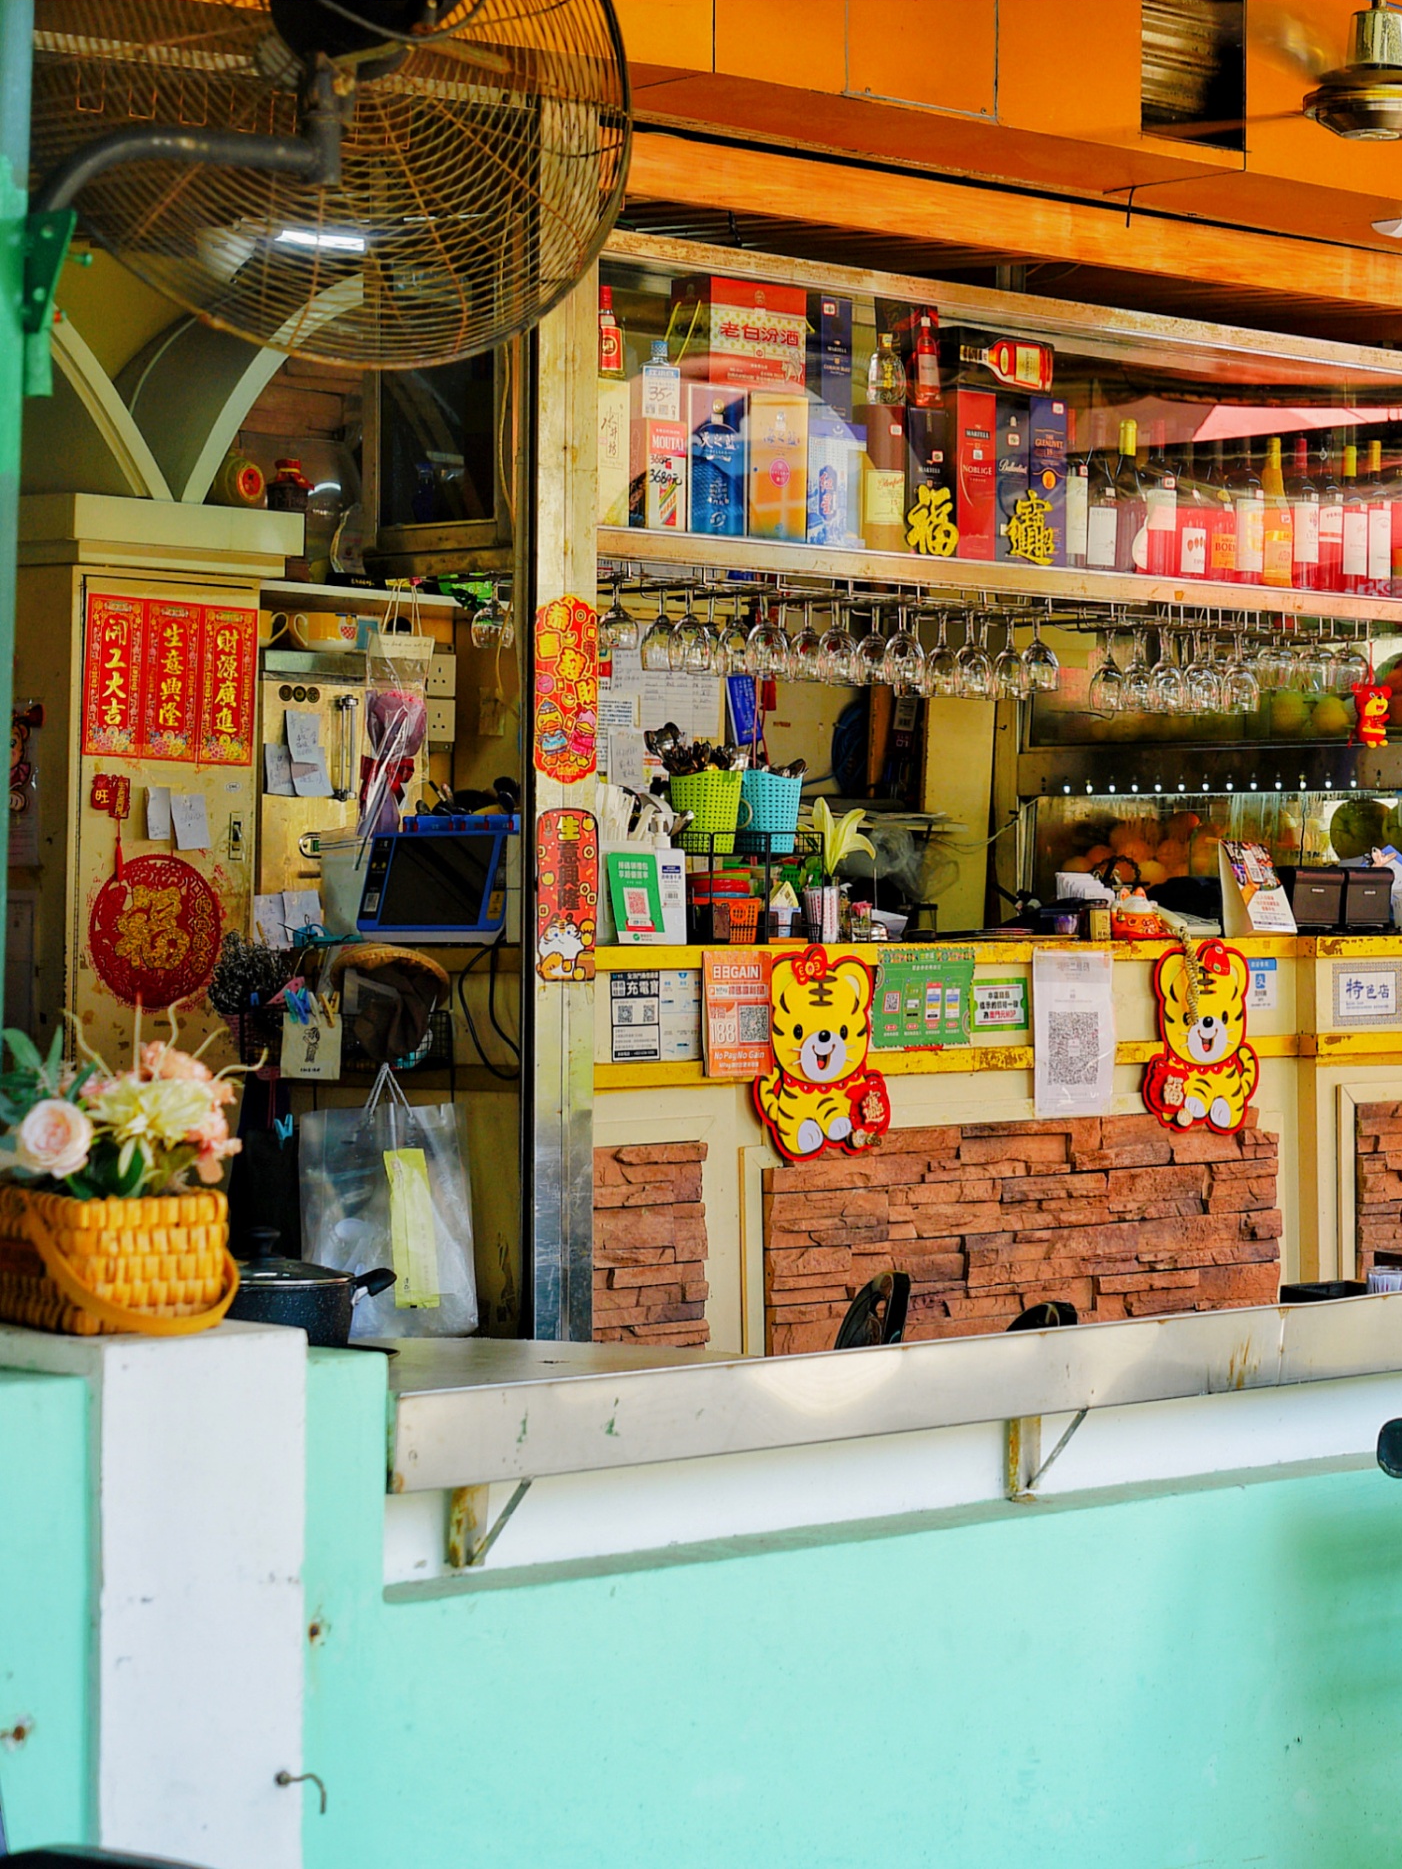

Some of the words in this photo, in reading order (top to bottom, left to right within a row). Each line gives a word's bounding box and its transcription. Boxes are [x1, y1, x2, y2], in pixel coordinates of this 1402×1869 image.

[720, 321, 799, 347] 老白汾酒
[652, 435, 685, 451] MOUTAI
[966, 429, 990, 439] MARTELL
[1034, 439, 1064, 450] GLENLIVET
[962, 465, 993, 476] NOBLIGE
[907, 484, 959, 557] 福
[102, 619, 128, 725] 開工大吉
[158, 623, 184, 727] 生意興隆
[213, 629, 239, 733] 財源廣進
[95, 789, 110, 804] 旺
[556, 815, 581, 911] 生意興隆
[115, 884, 190, 970] 福
[1346, 978, 1389, 1000] 特色店
[710, 1023, 736, 1043] 188
[724, 1051, 737, 1061] Pay
[749, 1051, 765, 1059] Gain
